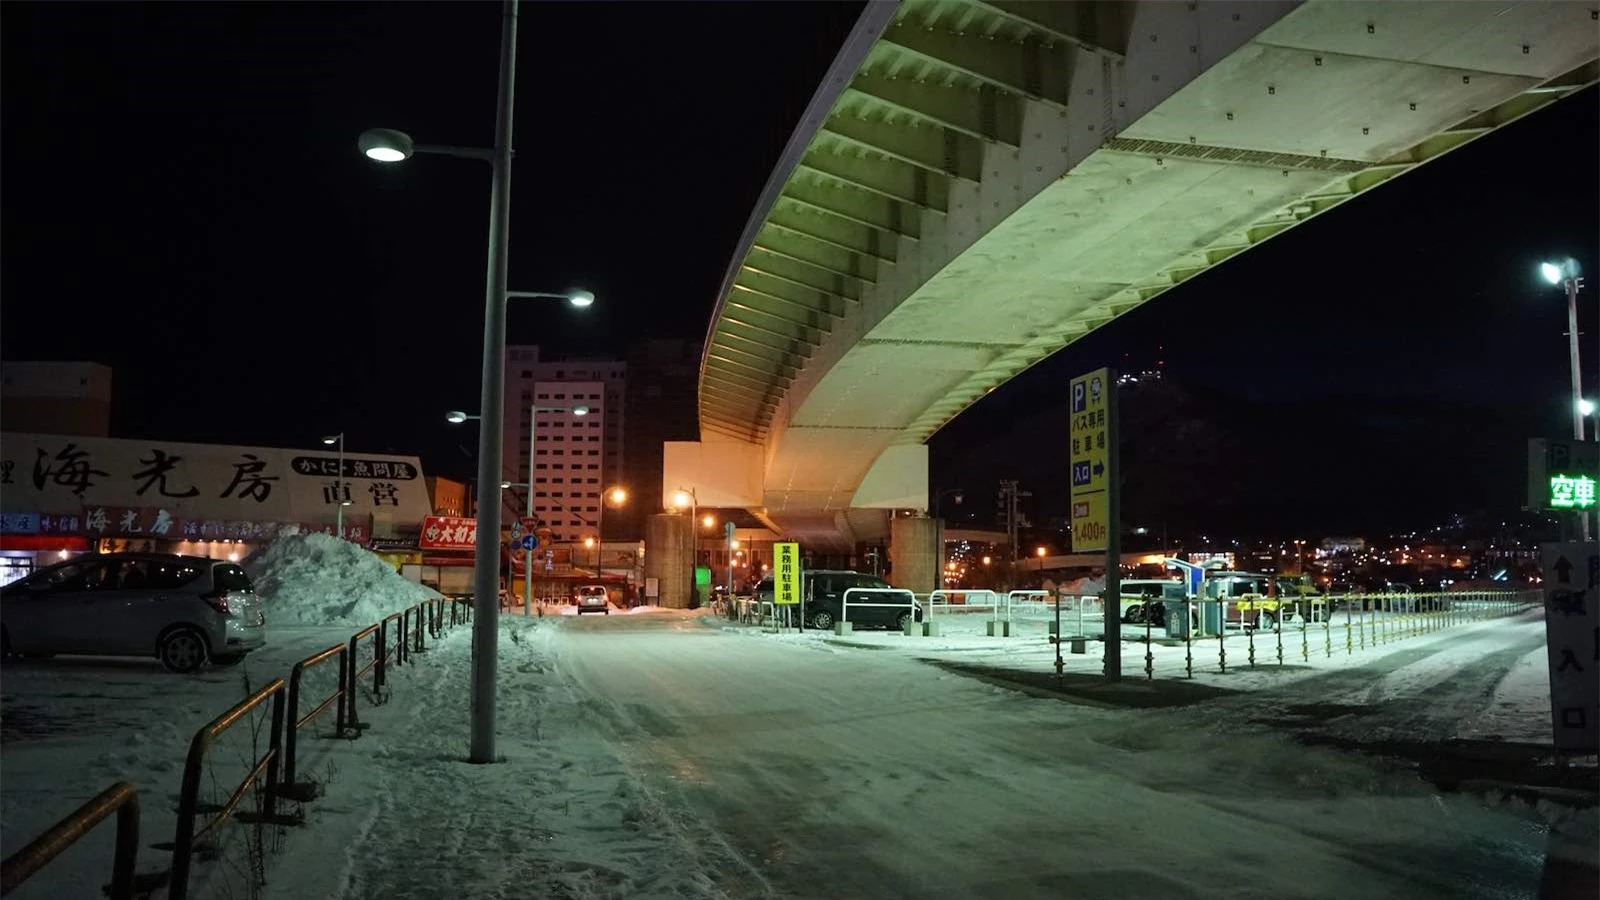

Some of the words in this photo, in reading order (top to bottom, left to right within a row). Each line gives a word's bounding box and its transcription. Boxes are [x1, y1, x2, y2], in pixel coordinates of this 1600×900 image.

[1075, 384, 1084, 411] P
[1072, 409, 1105, 432] バス専用
[1073, 432, 1105, 455] 駐車場
[33, 444, 278, 502] 海光房
[1074, 465, 1090, 483] 入口
[322, 481, 399, 506] 直営
[1550, 473, 1597, 508] 空車
[85, 509, 174, 534] 海光房
[1073, 521, 1106, 544] 1,400円
[781, 545, 793, 602] 業務用駐車場
